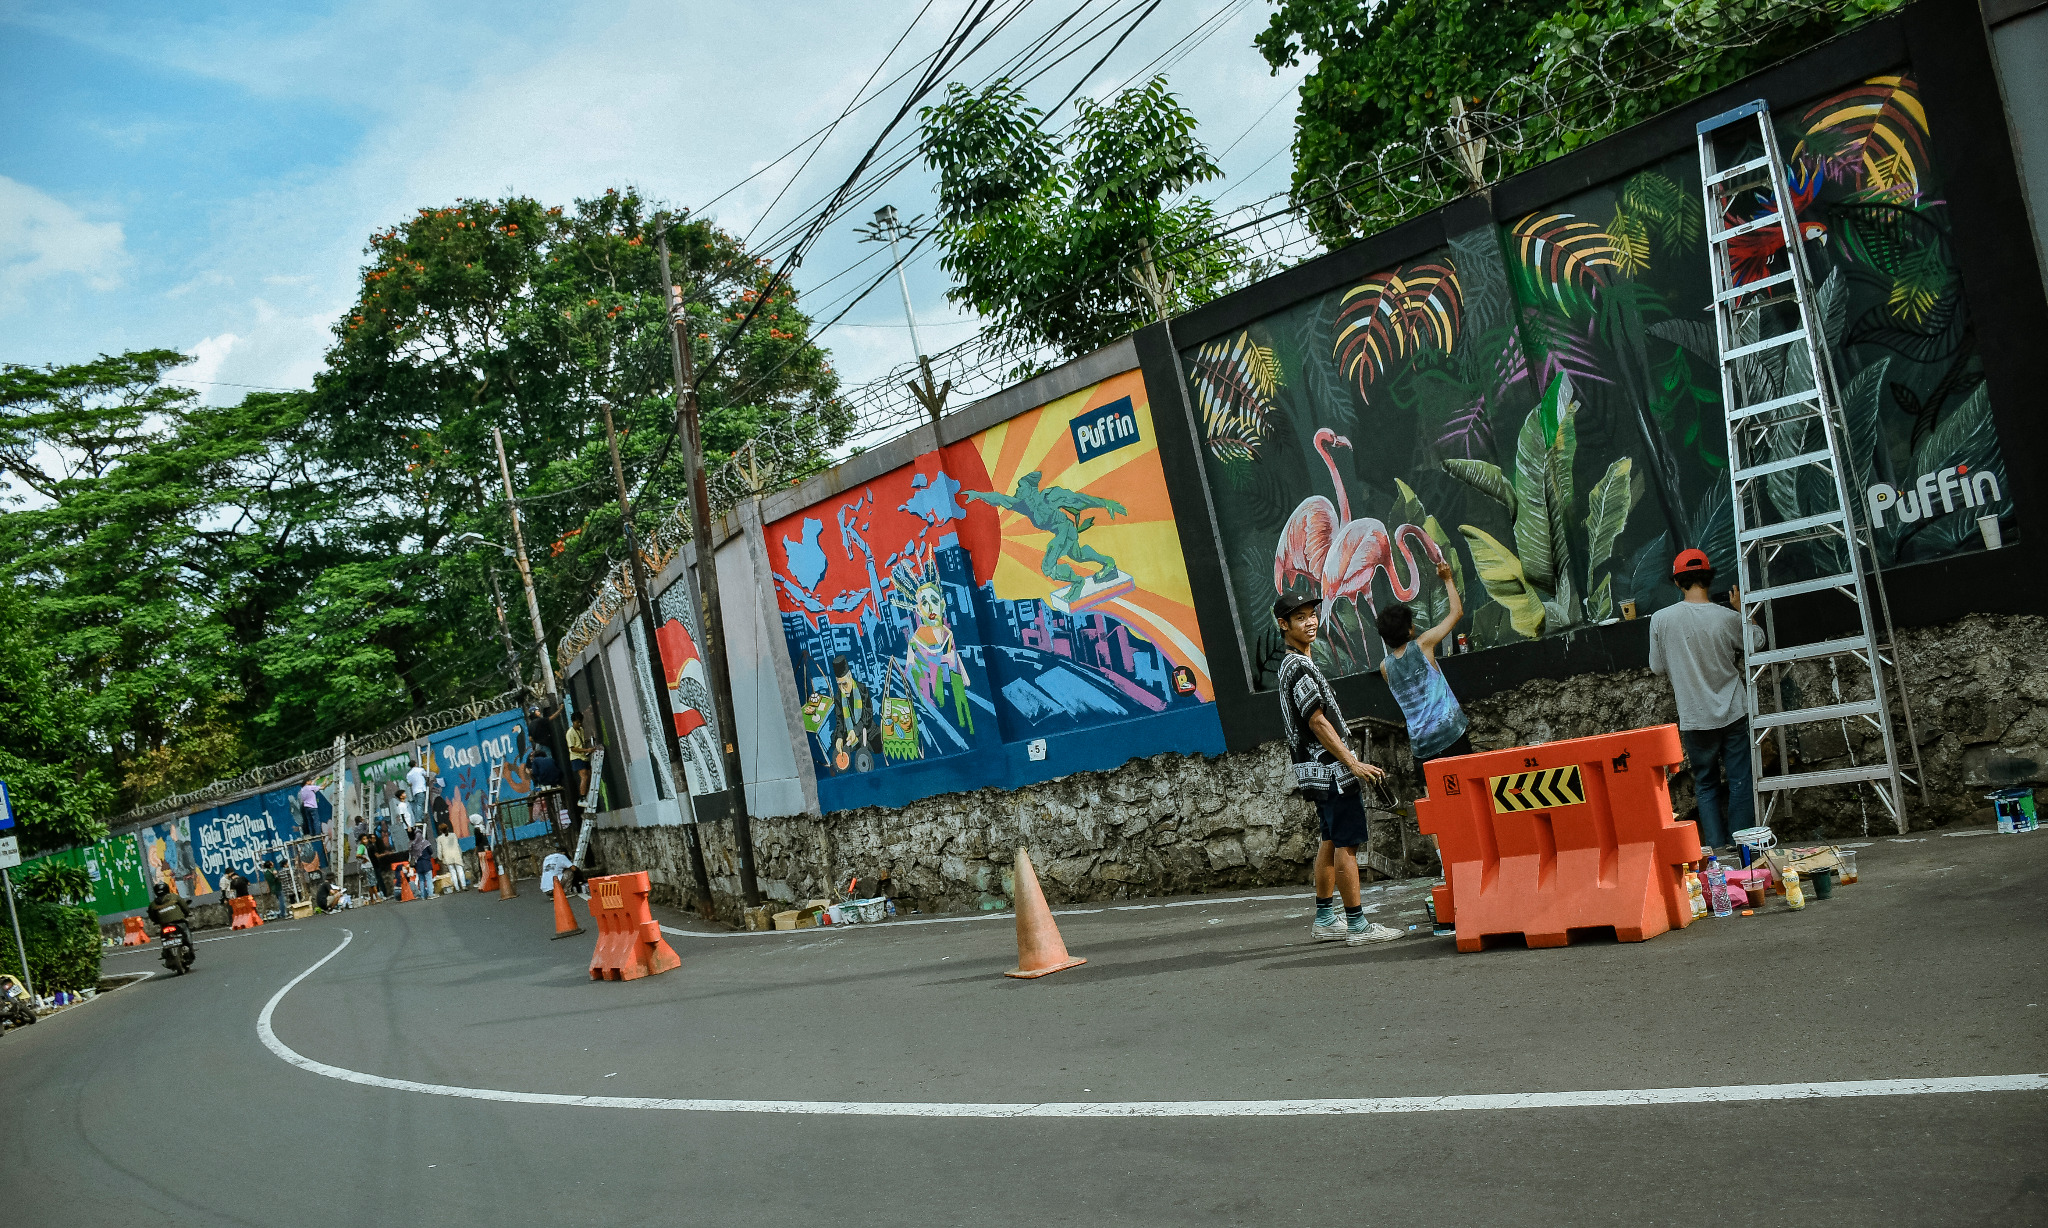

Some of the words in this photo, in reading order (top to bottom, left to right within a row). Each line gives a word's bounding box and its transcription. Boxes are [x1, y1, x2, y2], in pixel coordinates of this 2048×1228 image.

[1077, 412, 1135, 454] Puffin
[1866, 464, 2001, 529] Puffin
[1035, 745, 1040, 753] 5
[1524, 757, 1540, 768] 31
